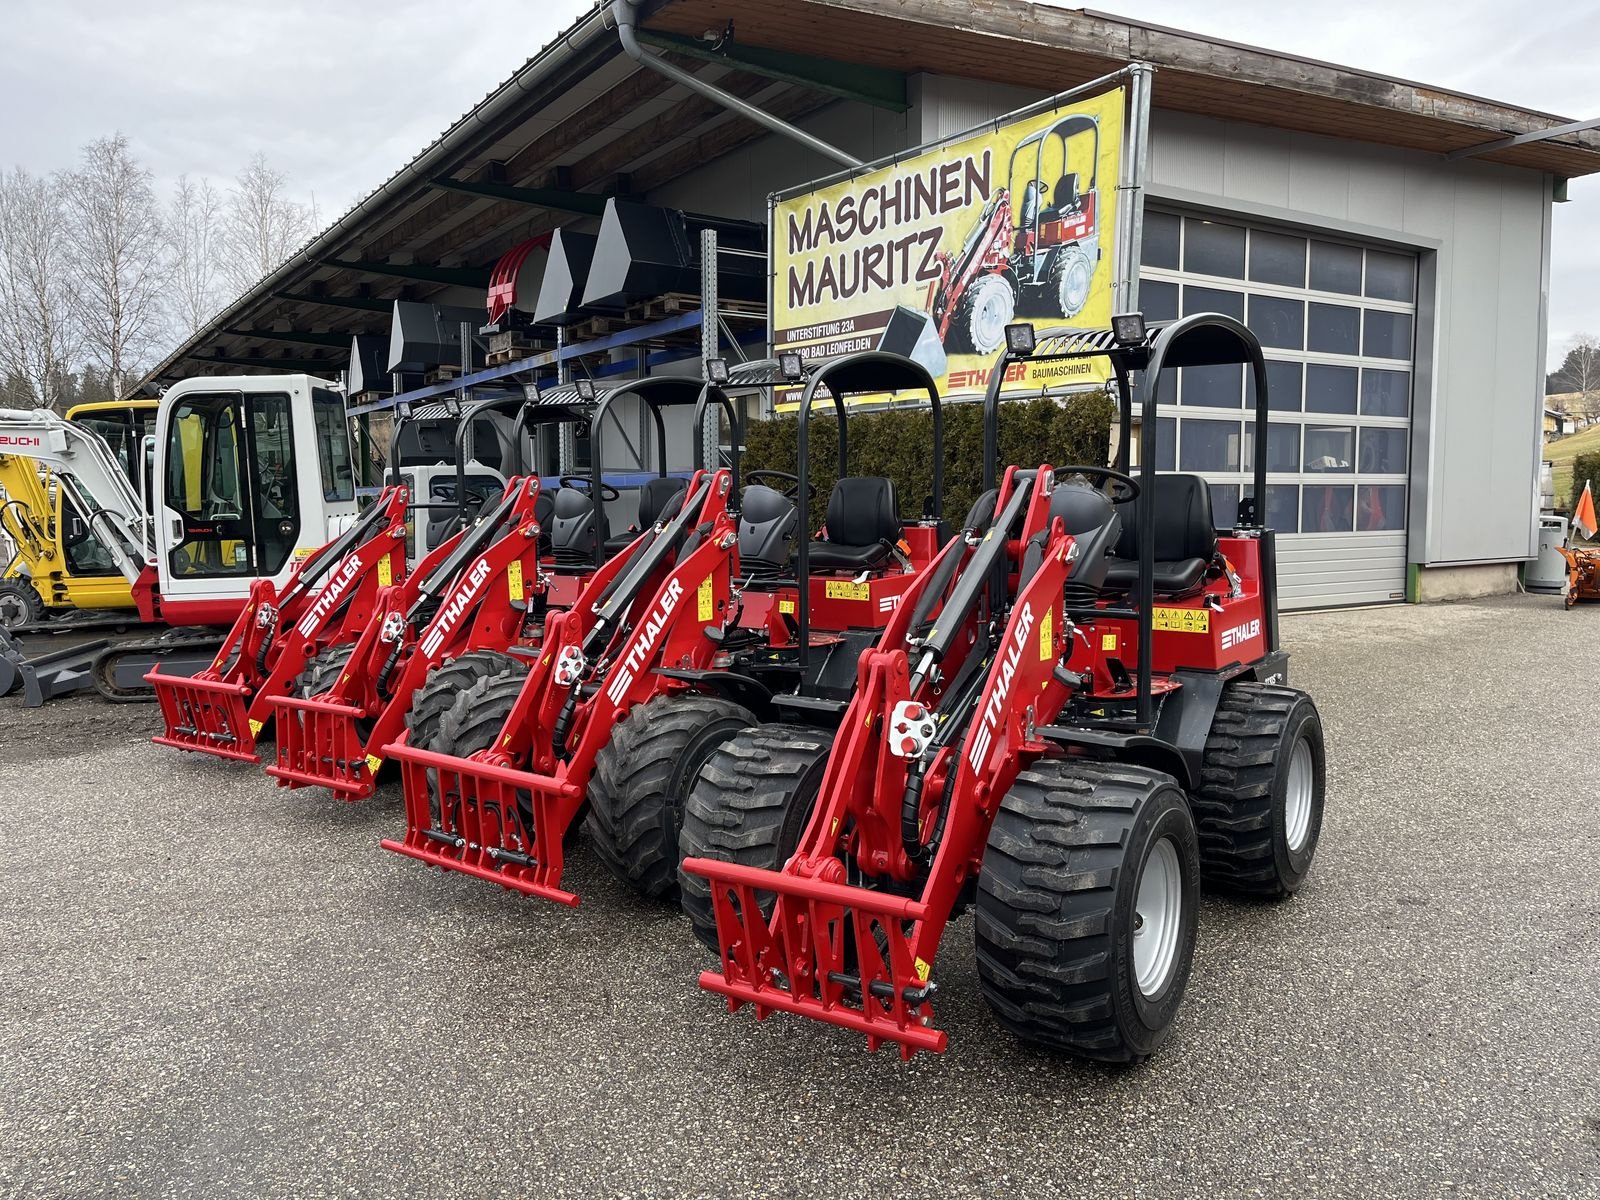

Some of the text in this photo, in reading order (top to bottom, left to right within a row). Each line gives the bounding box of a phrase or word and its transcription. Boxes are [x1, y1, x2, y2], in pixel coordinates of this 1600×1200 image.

[788, 150, 991, 255] MASCHINEN
[788, 226, 944, 309] MAURITZ
[786, 319, 855, 342] UNTERSTIFTUNG 23A
[810, 344, 825, 358] BAD
[826, 337, 871, 355] LEONFELDEN
[966, 363, 1027, 387] THER
[1032, 363, 1092, 379] BAUMASCHINEN
